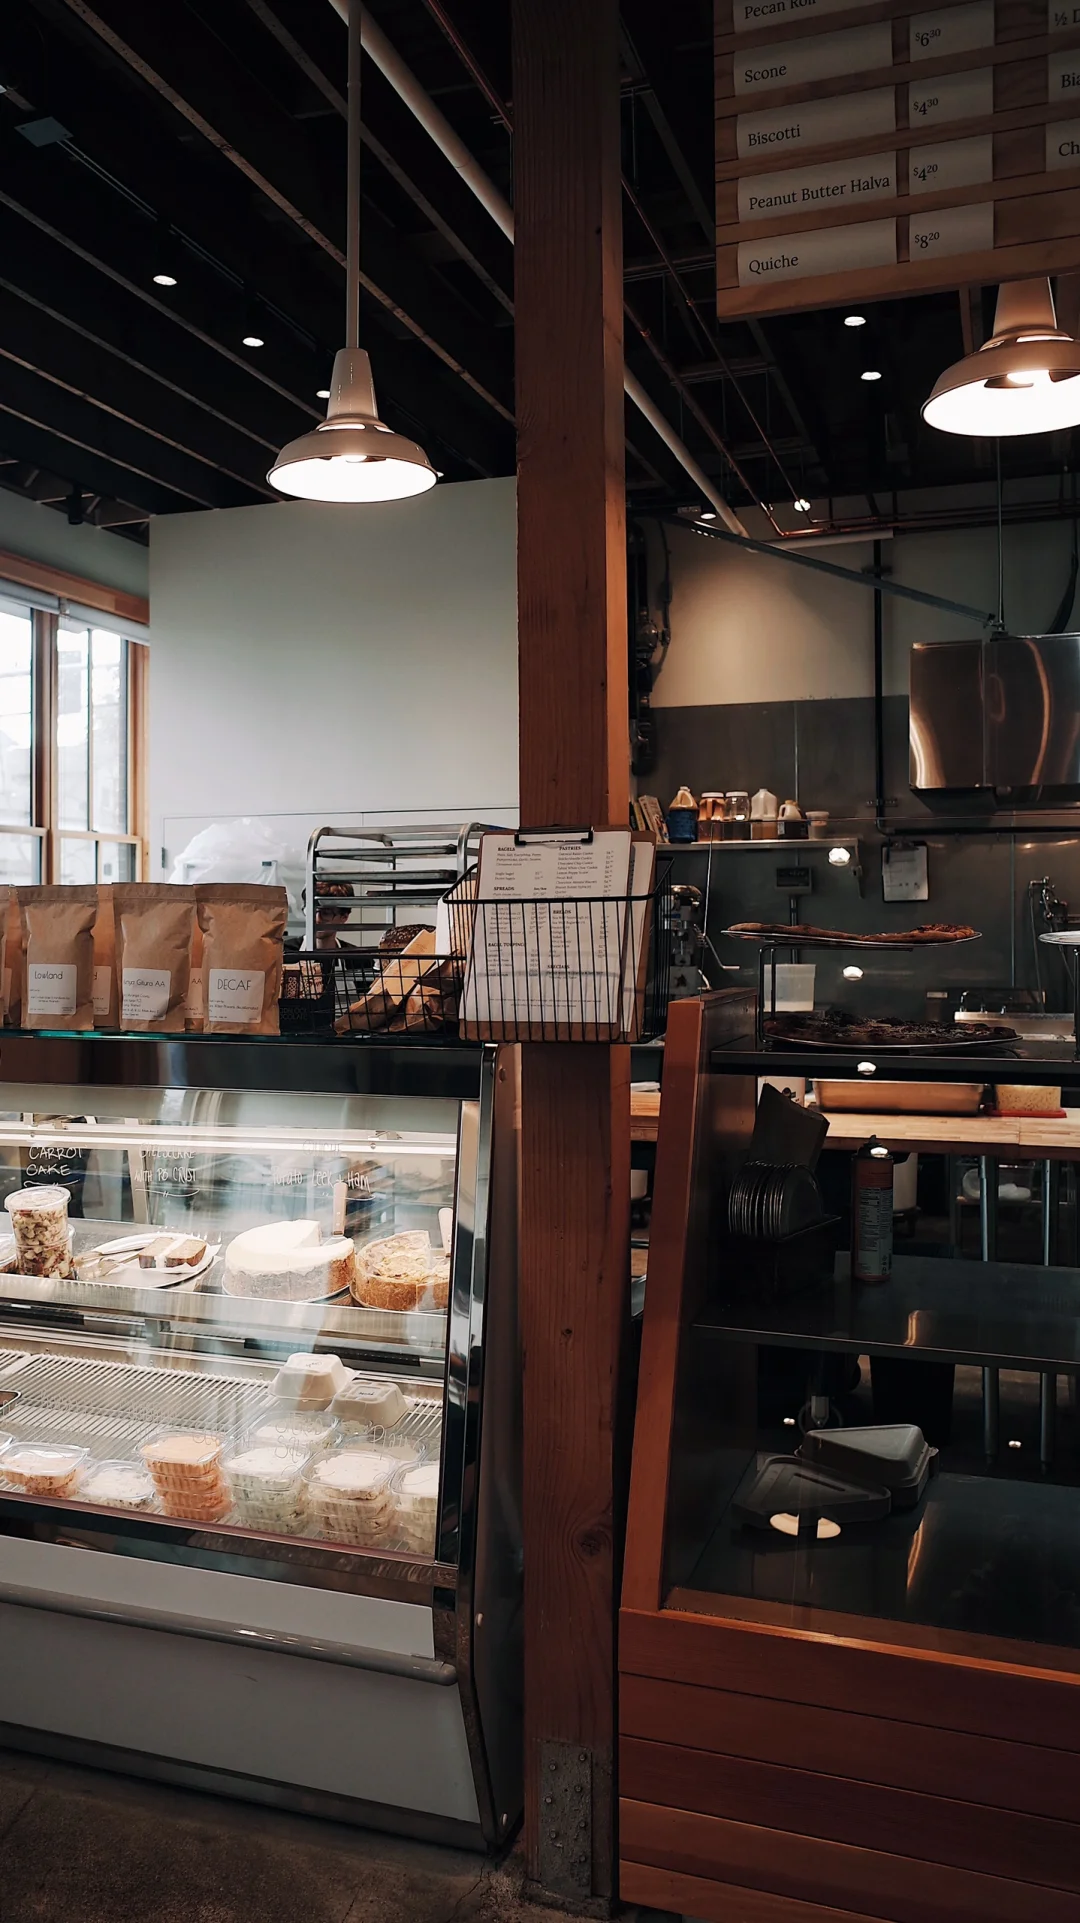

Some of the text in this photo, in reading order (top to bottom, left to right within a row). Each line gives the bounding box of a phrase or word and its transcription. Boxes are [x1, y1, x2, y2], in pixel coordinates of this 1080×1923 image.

[744, 2, 786, 19] Pecan
[744, 65, 787, 83] Scone
[748, 124, 801, 147] Biscotti
[749, 176, 891, 210] Peanut Butter Halva
[748, 255, 799, 274] Quiche
[217, 978, 252, 991] DECAF
[29, 1144, 85, 1161] CARROT
[26, 1163, 71, 1177] CAKE
[173, 1166, 197, 1184] CRUST
